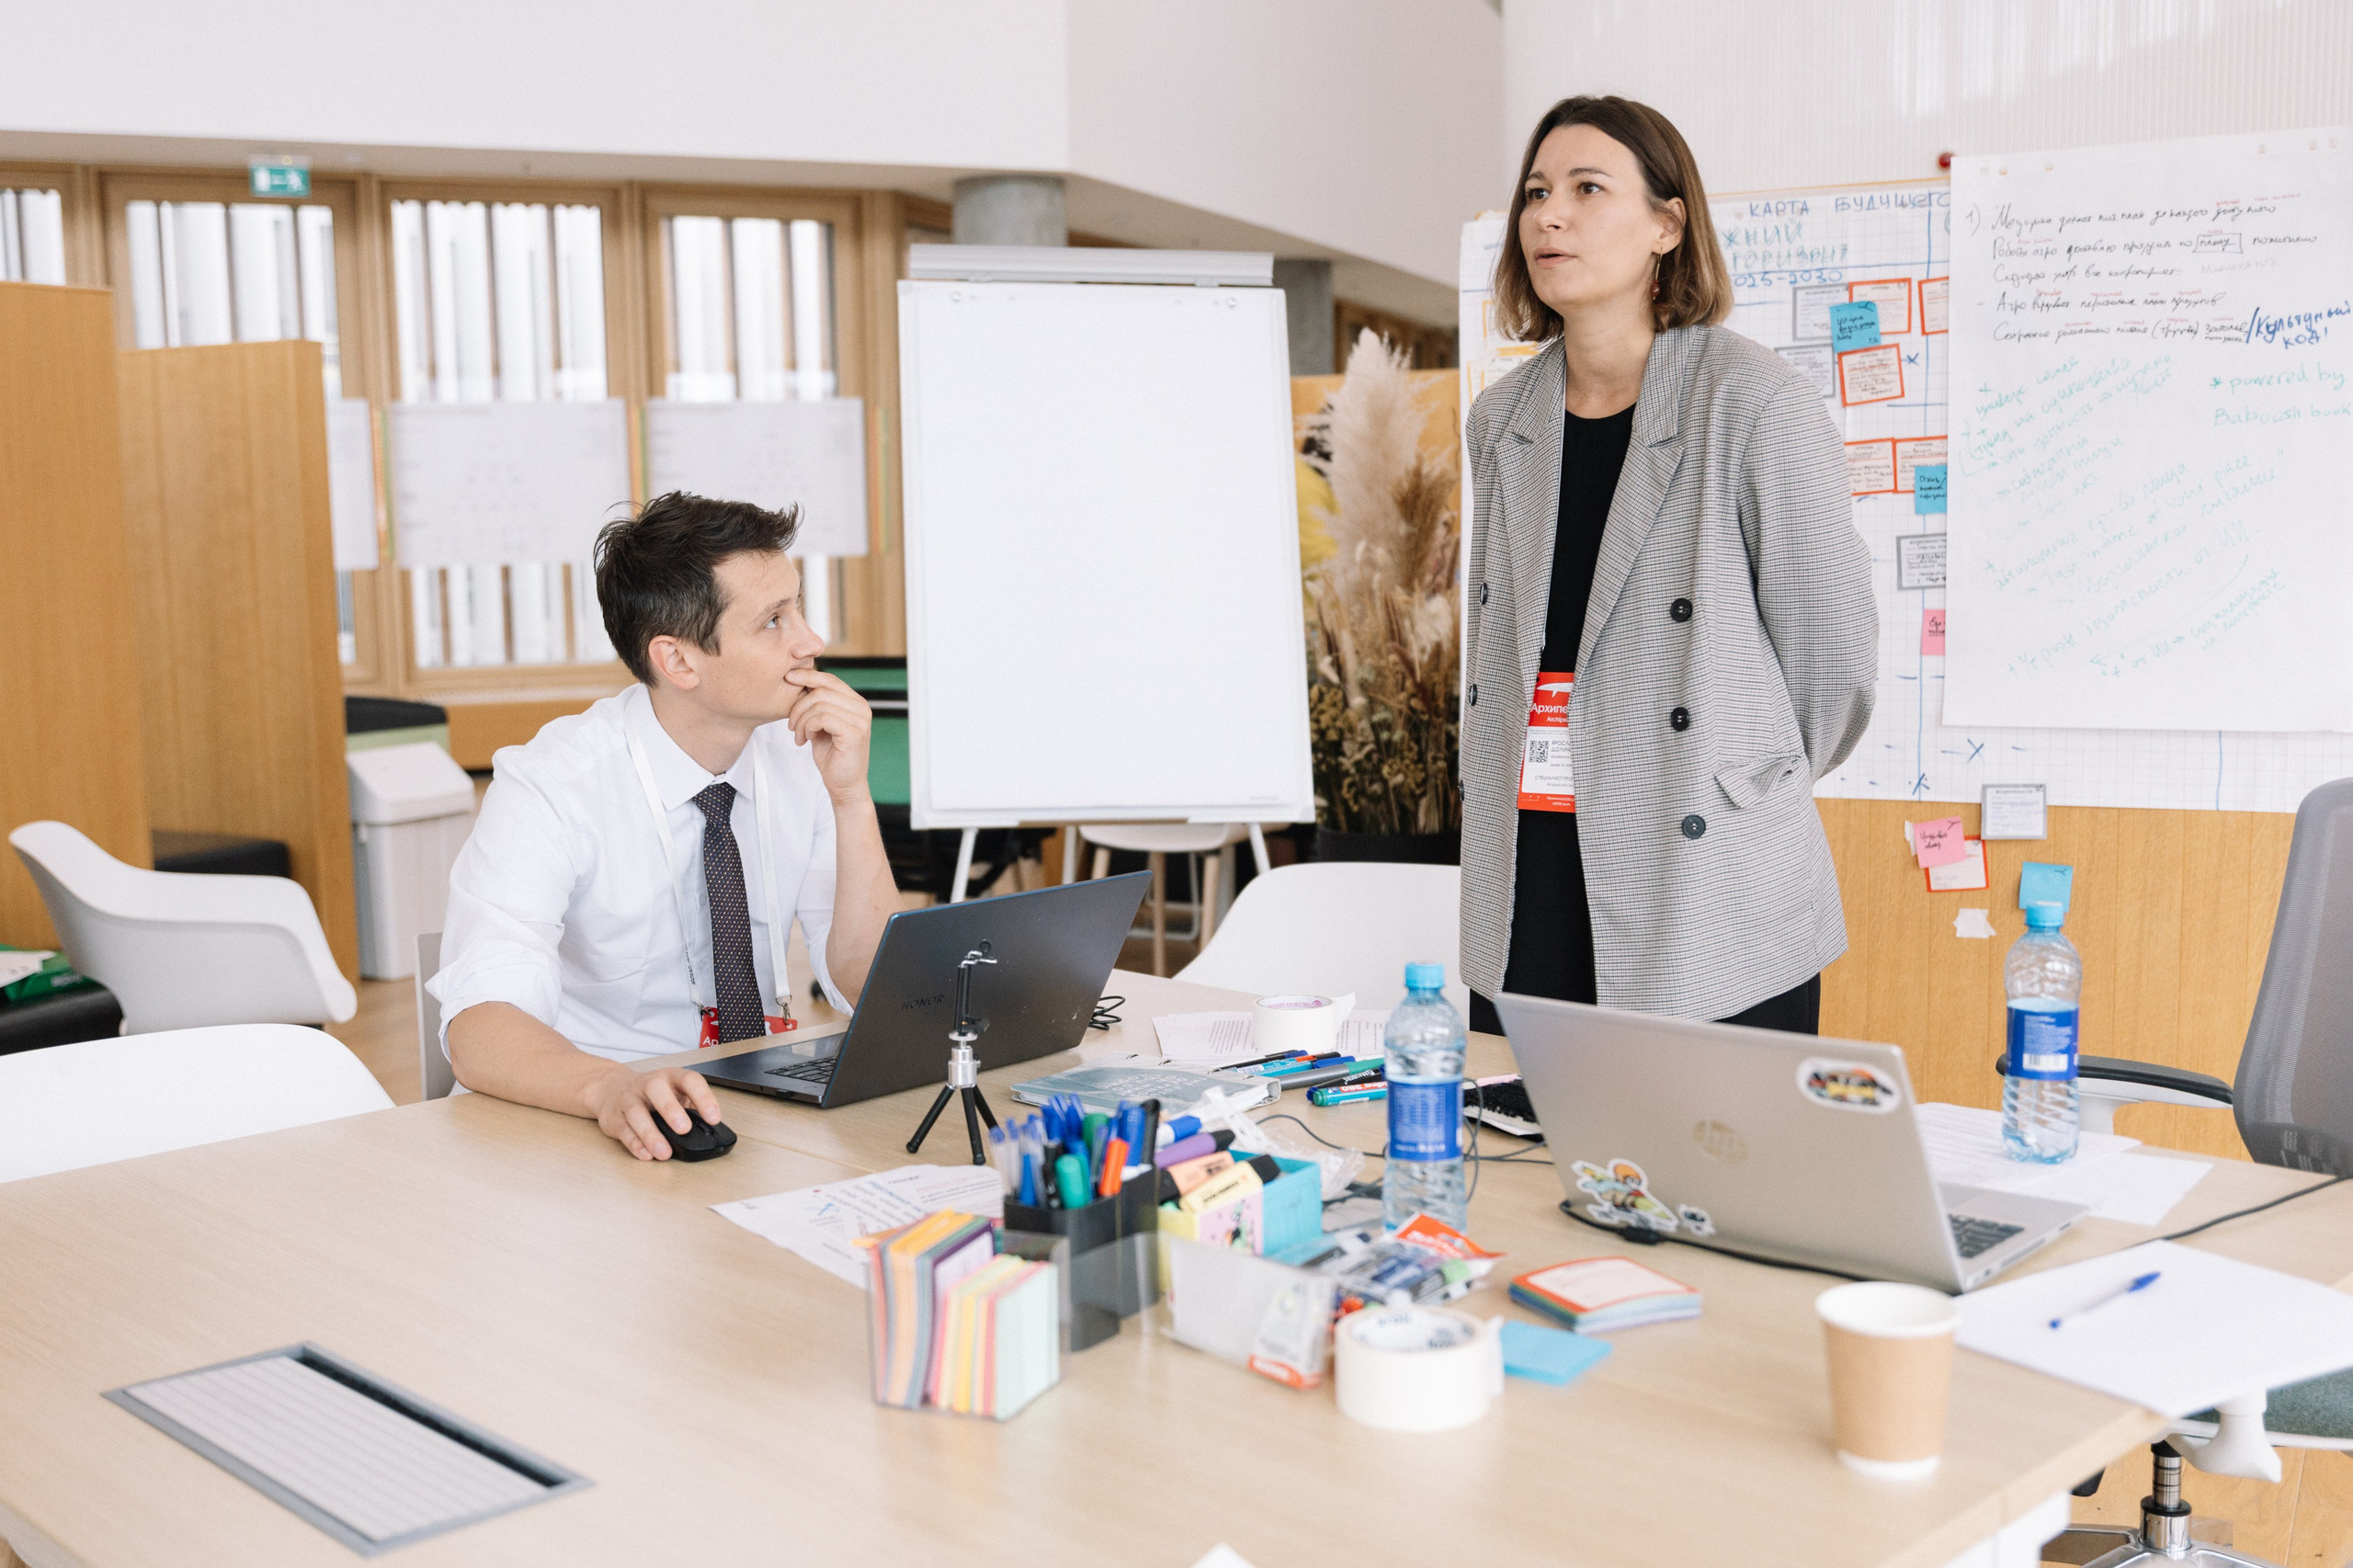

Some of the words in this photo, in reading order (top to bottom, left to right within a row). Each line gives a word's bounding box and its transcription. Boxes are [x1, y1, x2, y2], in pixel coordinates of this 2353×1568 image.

[1749, 200, 1810, 218] КАРТА
[1722, 221, 1802, 248] ЖНИЙ
[1733, 243, 1848, 270] ГОРИЗОНТ
[1734, 269, 1844, 288] 025-2030
[2229, 362, 2309, 395] powered
[2317, 361, 2347, 392] by
[1530, 702, 1568, 715] Архипе
[1546, 716, 1568, 724] Archipe
[901, 994, 945, 1010] HONOR
[702, 1036, 719, 1047] Ар
